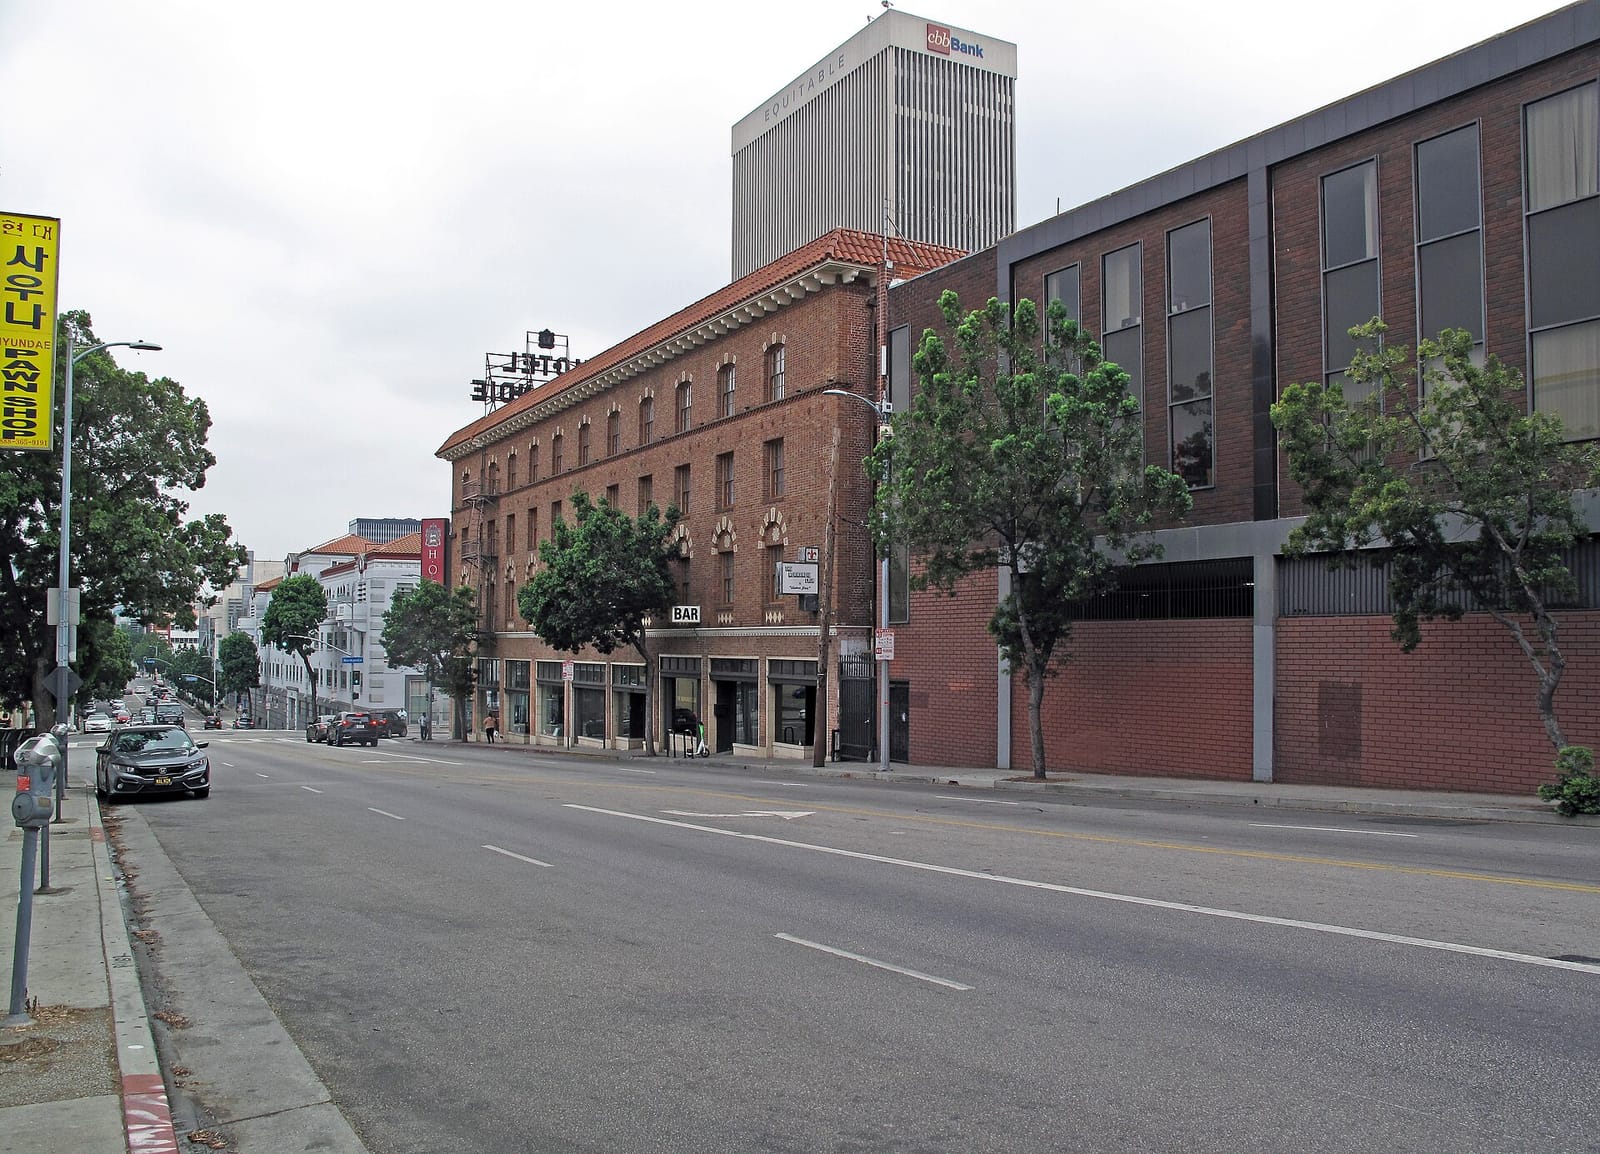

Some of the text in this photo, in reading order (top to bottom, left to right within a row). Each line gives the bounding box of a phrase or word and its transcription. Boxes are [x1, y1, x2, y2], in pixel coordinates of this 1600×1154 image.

[764, 54, 845, 121] EQUITABLE
[4, 245, 49, 330] 사우나
[1, 348, 41, 393] PAWN
[2, 396, 38, 440] SHOP
[674, 608, 698, 621] BAR
